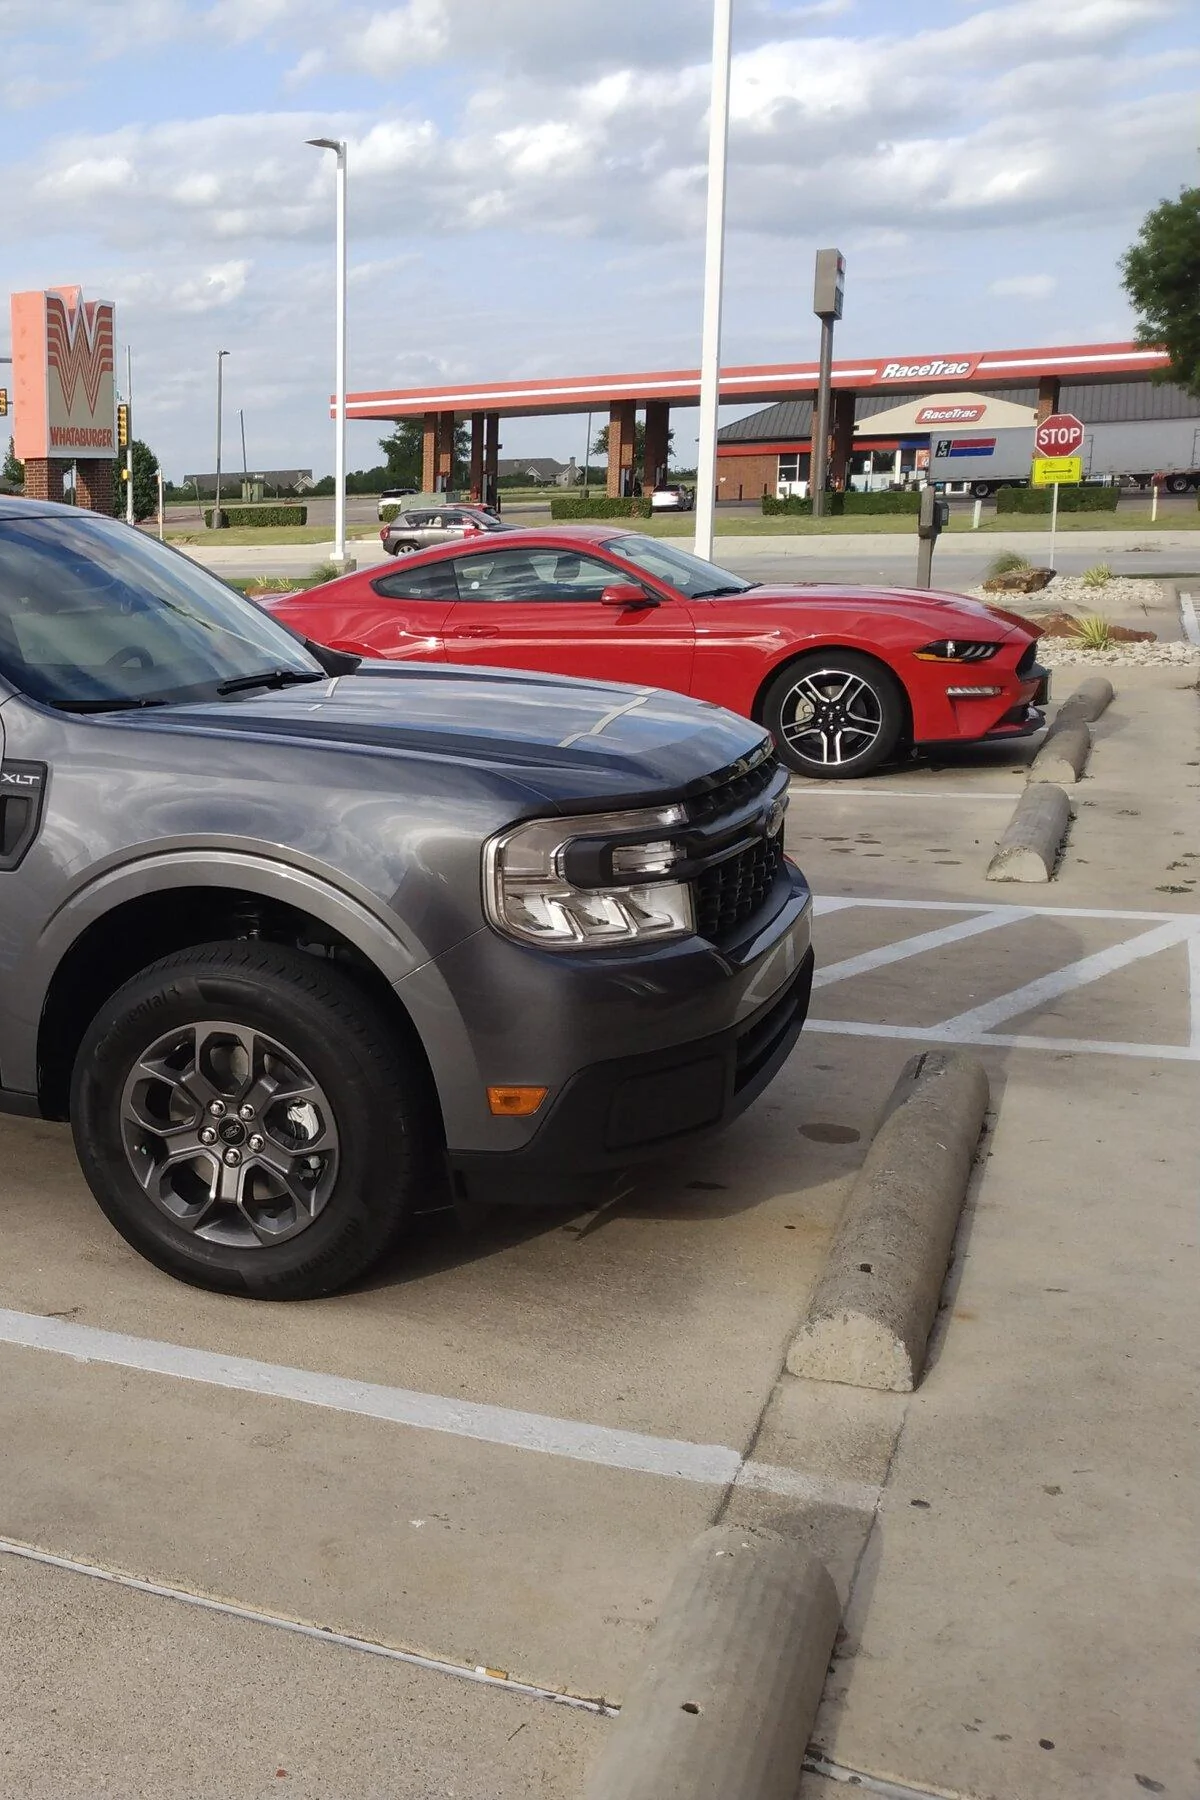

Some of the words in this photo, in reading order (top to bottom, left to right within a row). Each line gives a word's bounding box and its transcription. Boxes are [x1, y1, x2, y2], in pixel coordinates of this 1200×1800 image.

[881, 360, 970, 378] RaceTrac
[921, 408, 978, 420] RaceTrac
[50, 426, 113, 447] WHATABURGER
[1038, 427, 1081, 445] STOP
[1, 773, 40, 785] XLT
